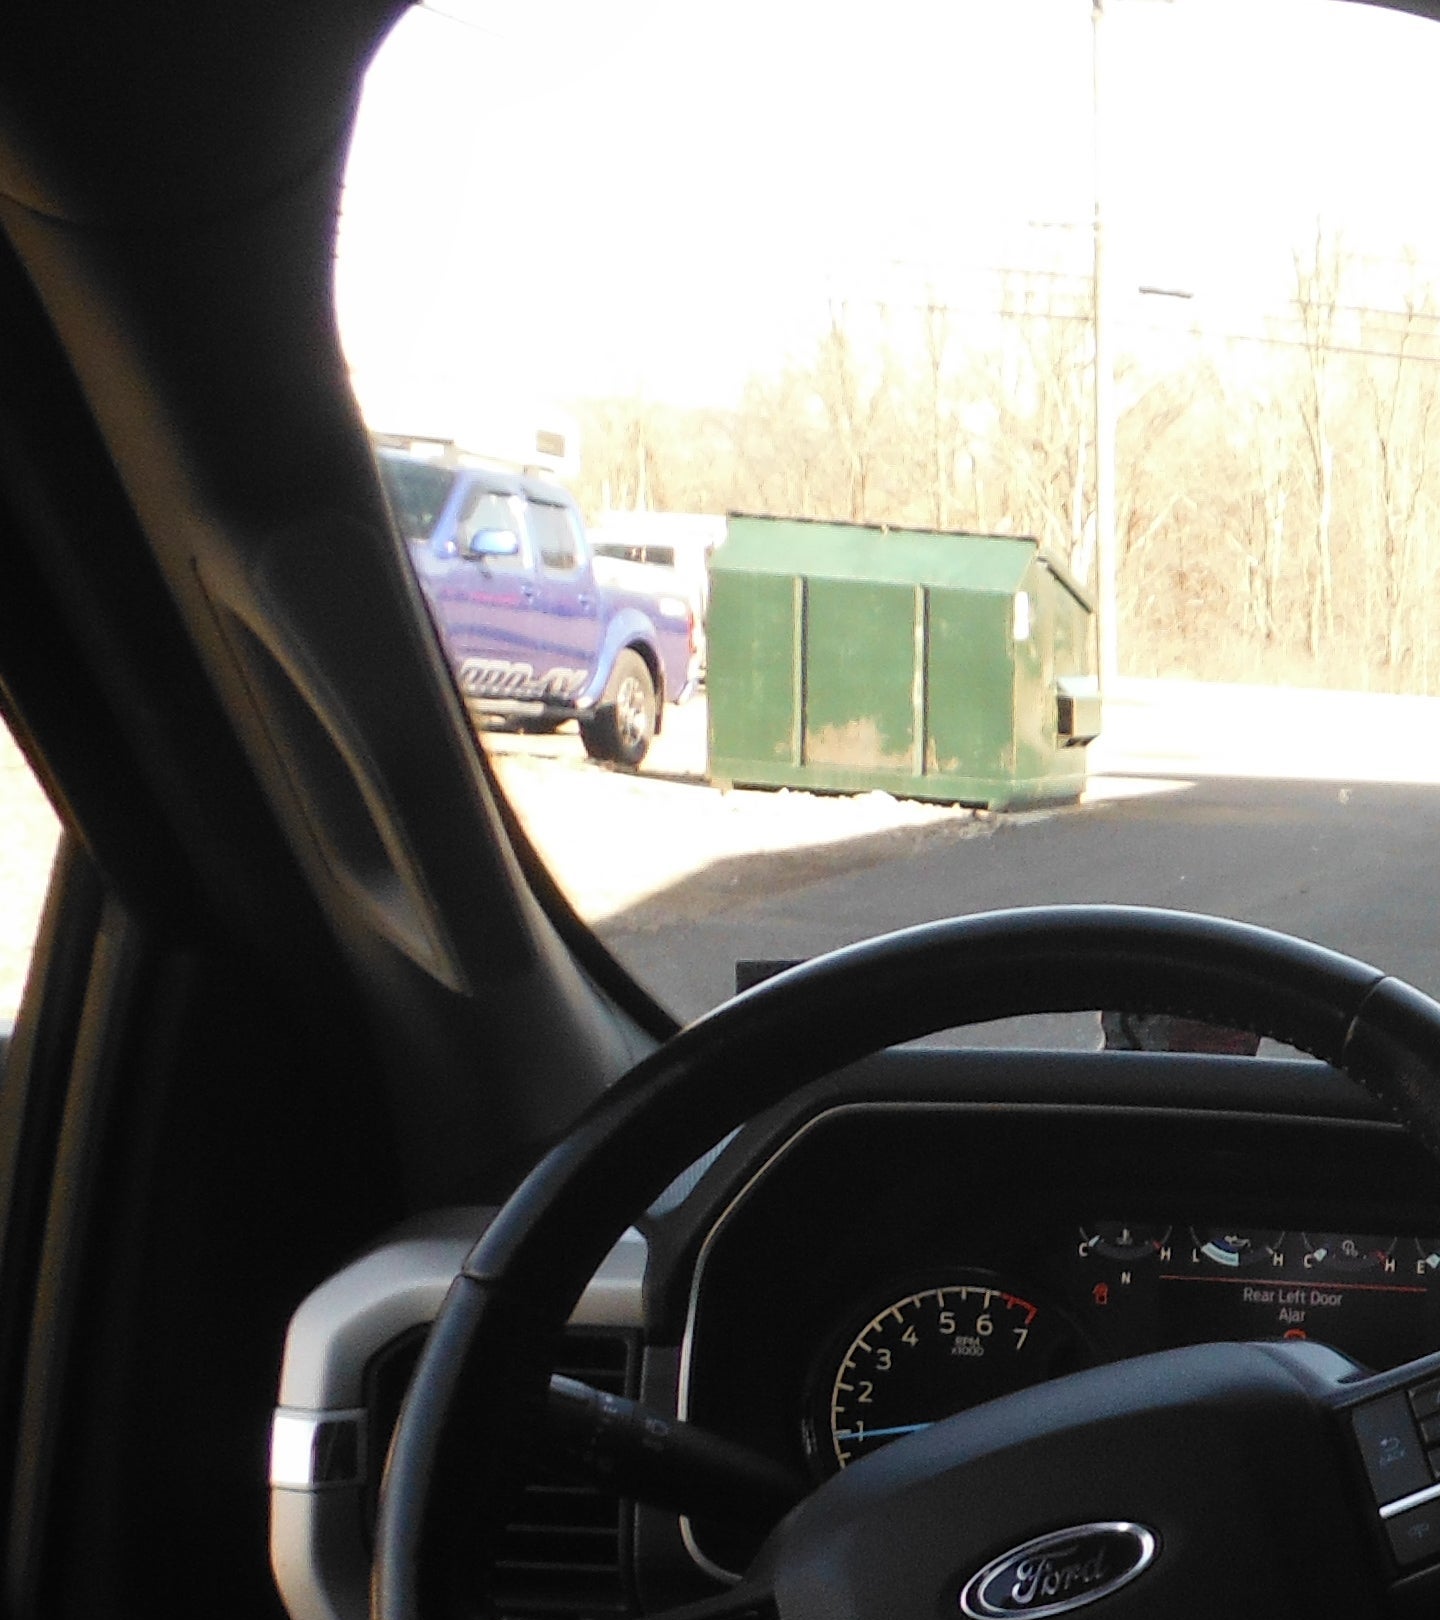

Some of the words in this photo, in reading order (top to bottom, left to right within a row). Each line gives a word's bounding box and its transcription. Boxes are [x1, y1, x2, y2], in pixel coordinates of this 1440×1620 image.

[1078, 1241, 1089, 1258] C
[1159, 1246, 1173, 1262] H
[1191, 1247, 1201, 1263] L
[1272, 1252, 1285, 1268] H
[1303, 1253, 1313, 1269] C
[1384, 1257, 1397, 1273] H
[1416, 1258, 1426, 1275] E
[1120, 1270, 1132, 1285] N
[1243, 1286, 1275, 1303] Rear
[1278, 1287, 1306, 1304] Left
[1309, 1289, 1343, 1306] Door
[938, 1311, 957, 1335] 5
[975, 1312, 994, 1337] 6
[1278, 1306, 1306, 1324] Ajar
[900, 1324, 919, 1347] 4
[1012, 1326, 1029, 1352] 7
[875, 1347, 893, 1372] 3
[856, 1380, 875, 1404] 2
[855, 1419, 865, 1442] 1
[1010, 1545, 1108, 1605] Ford
